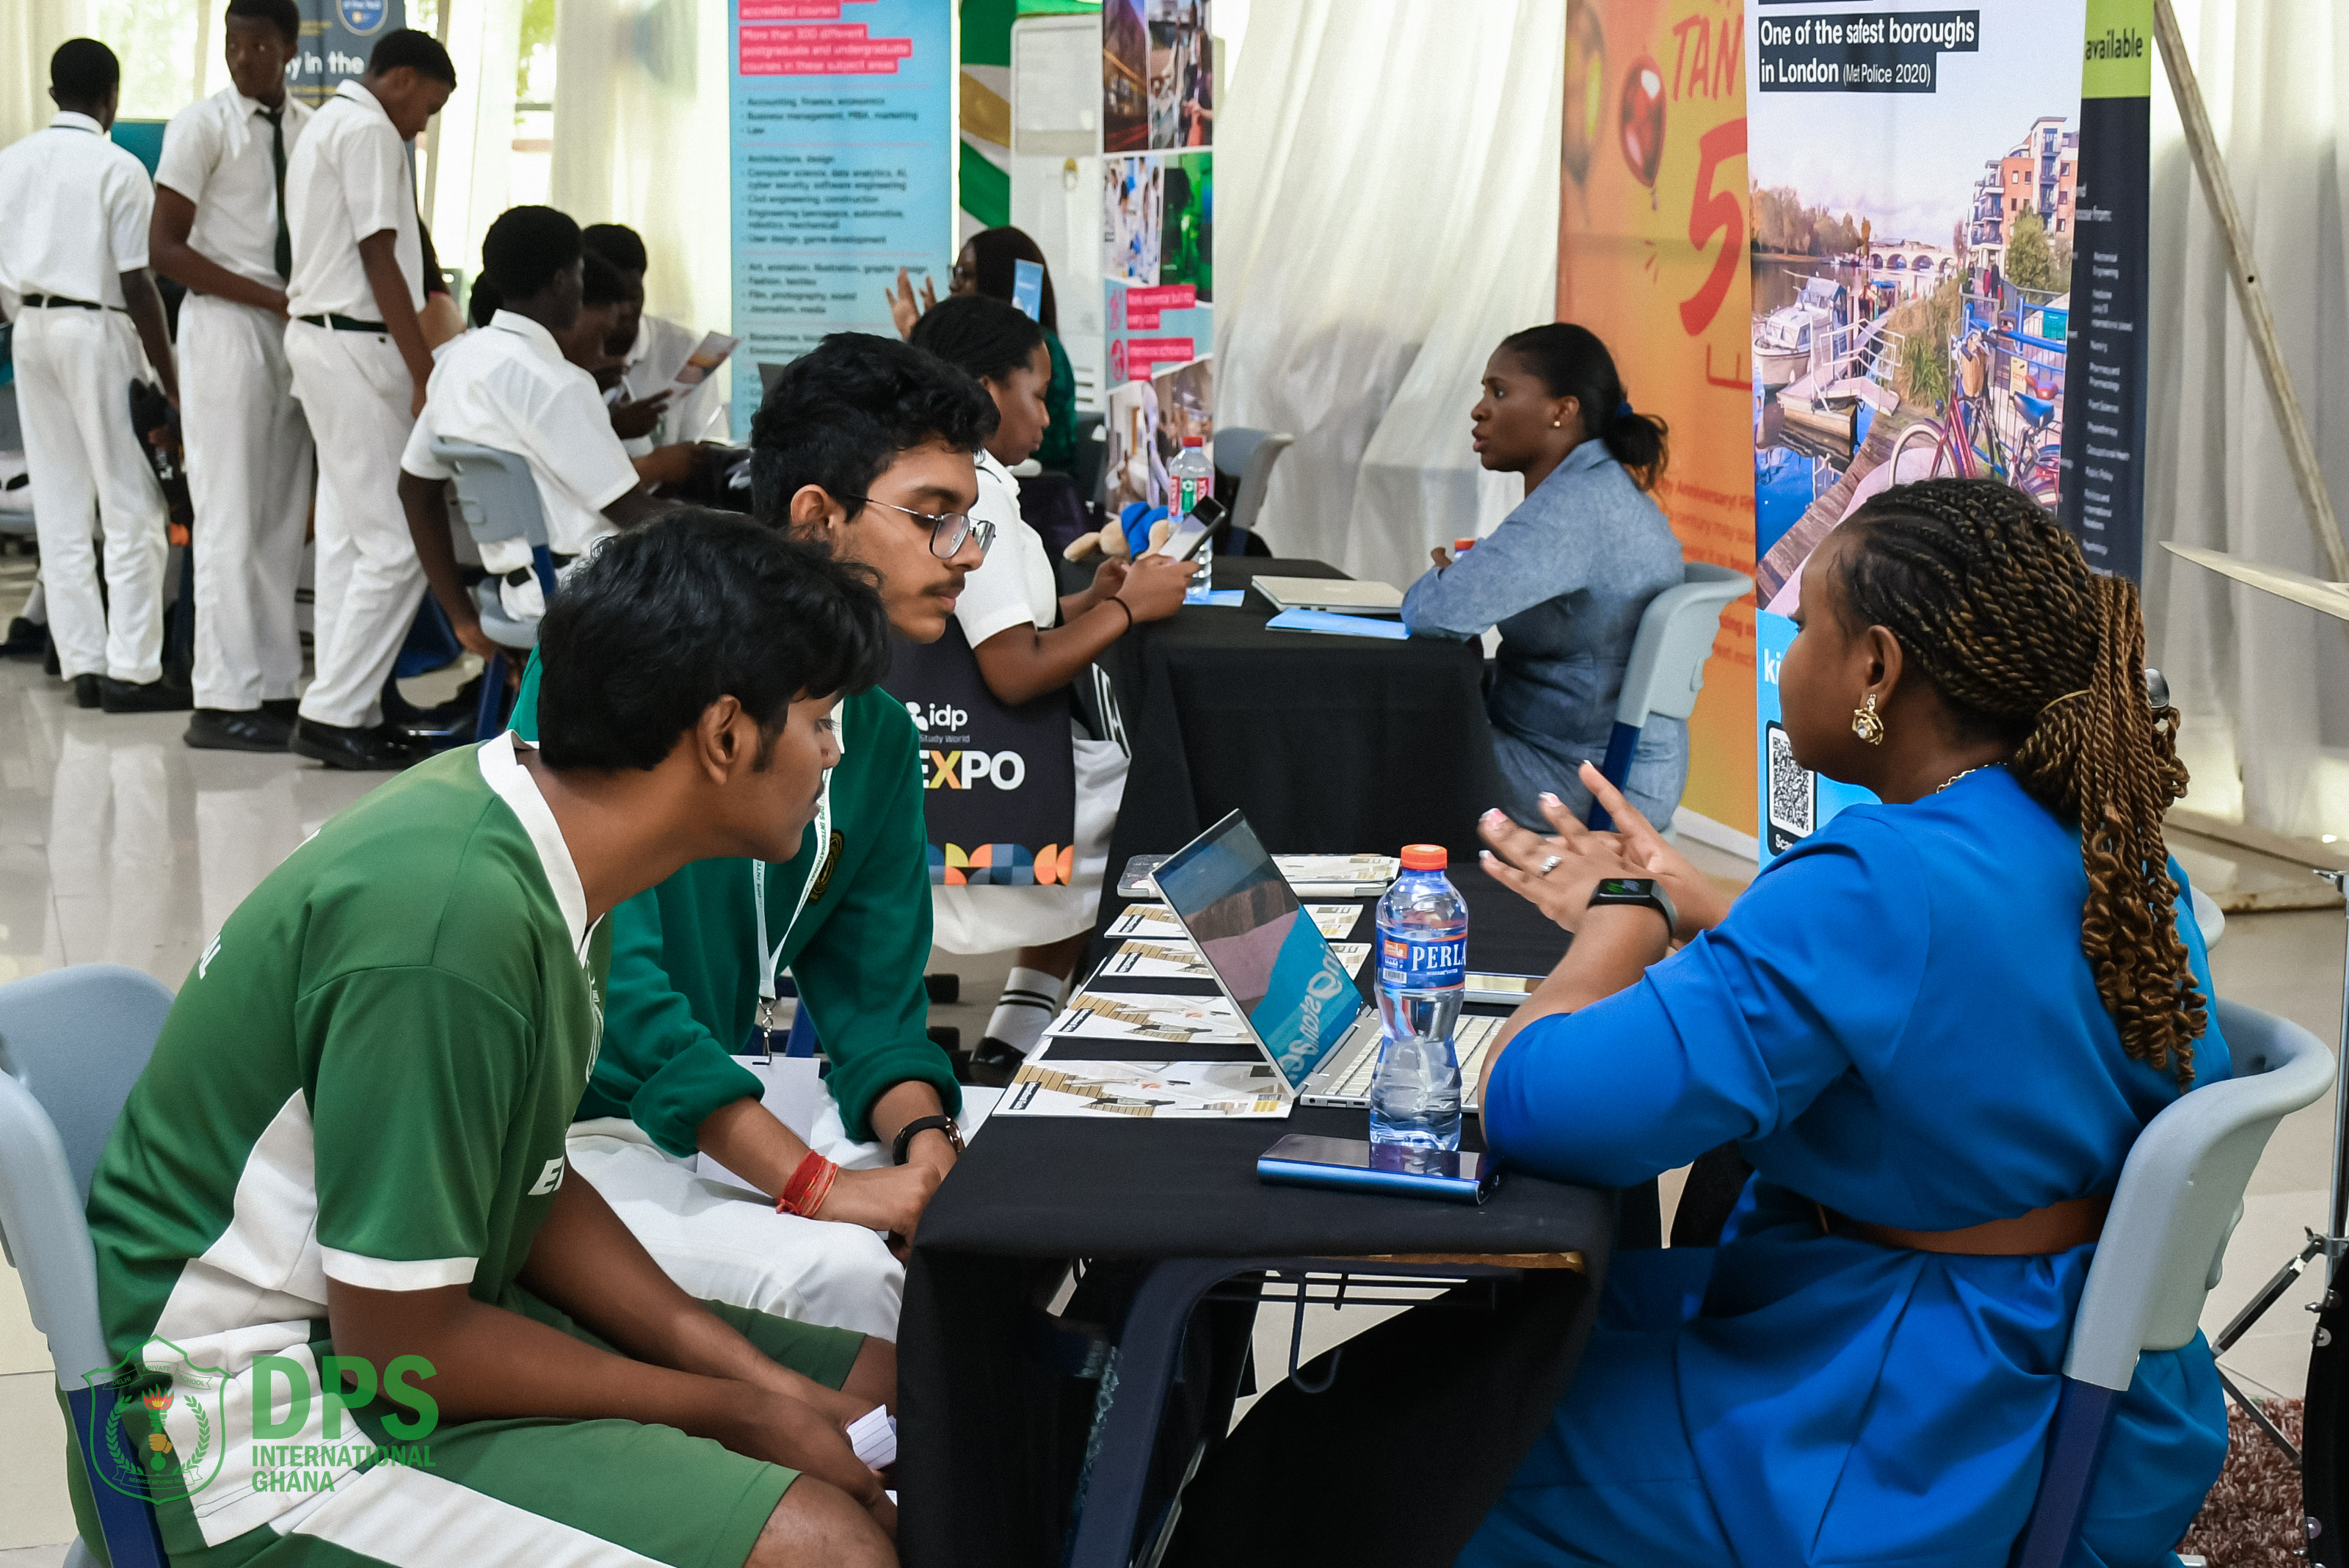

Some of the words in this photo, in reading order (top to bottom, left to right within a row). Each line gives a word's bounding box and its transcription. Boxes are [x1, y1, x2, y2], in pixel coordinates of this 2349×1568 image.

[1761, 21, 1791, 46] One
[1796, 20, 1811, 45] of
[1815, 19, 1842, 44] the
[1846, 18, 1884, 43] safest
[1889, 16, 1975, 48] boroughs
[2085, 28, 2143, 59] available
[328, 51, 365, 74] the
[1761, 59, 1774, 82] in
[1779, 58, 1839, 82] London
[1862, 64, 1892, 82] Police
[1895, 63, 1931, 87] 2020)
[929, 703, 968, 731] idp
[920, 735, 944, 744] Study
[945, 735, 970, 743] World
[919, 749, 1025, 791] EXPO
